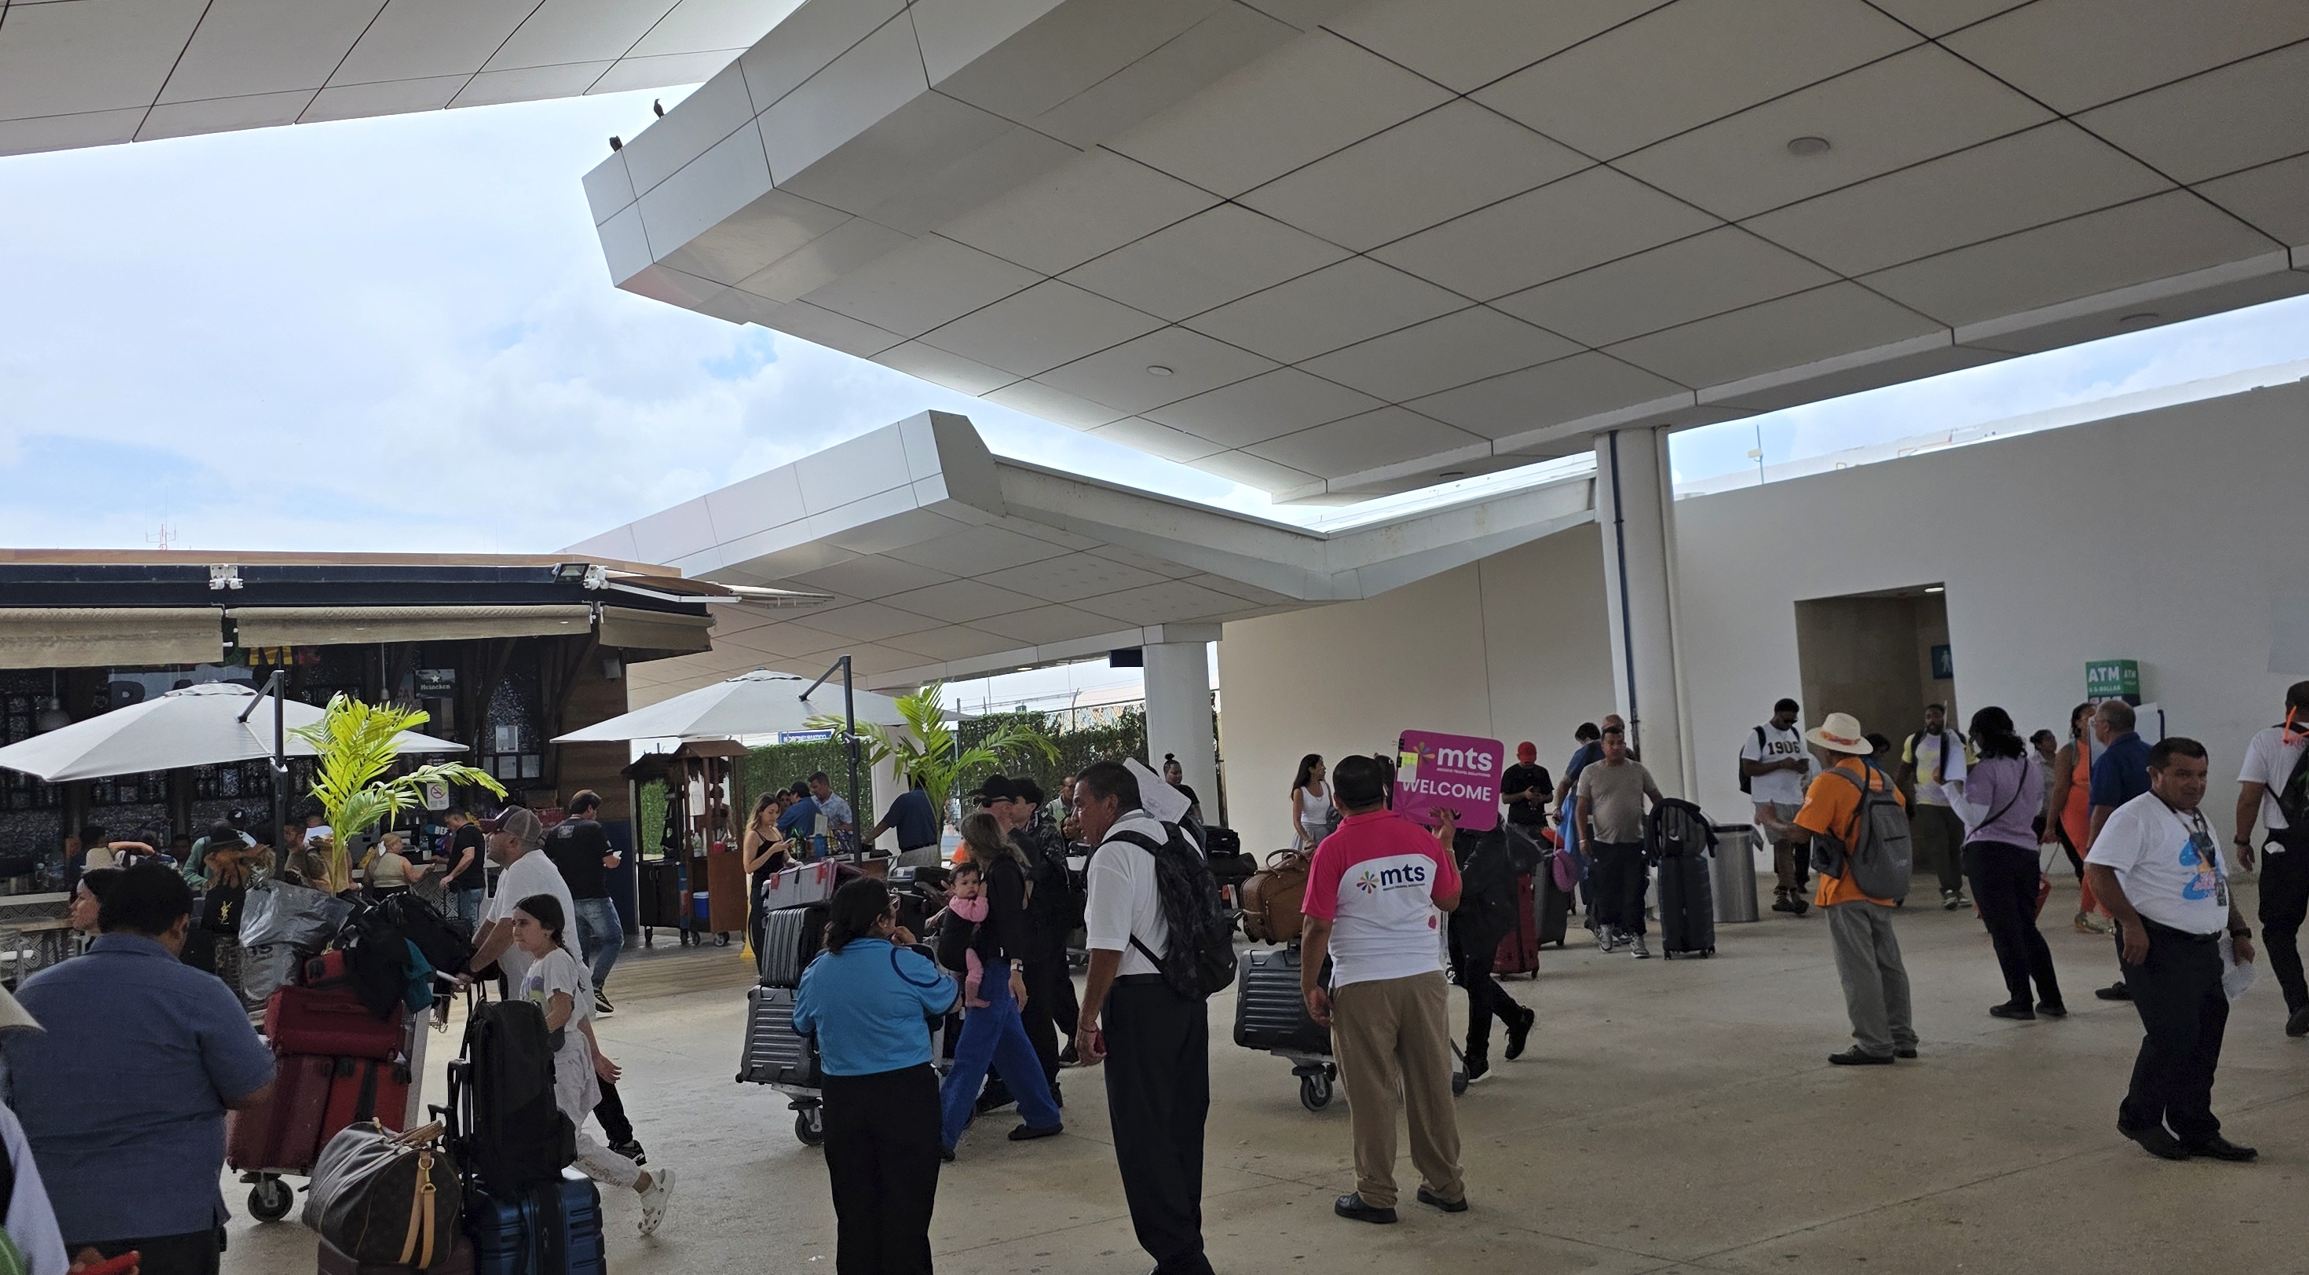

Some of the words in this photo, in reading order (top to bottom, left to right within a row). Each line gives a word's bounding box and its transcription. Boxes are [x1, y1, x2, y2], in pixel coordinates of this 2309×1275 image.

[2088, 666, 2120, 682] ATM
[1768, 740, 1801, 755] 1906
[1437, 747, 1493, 772] mts
[1402, 778, 1492, 802] WELCOME
[1380, 864, 1426, 886] mts
